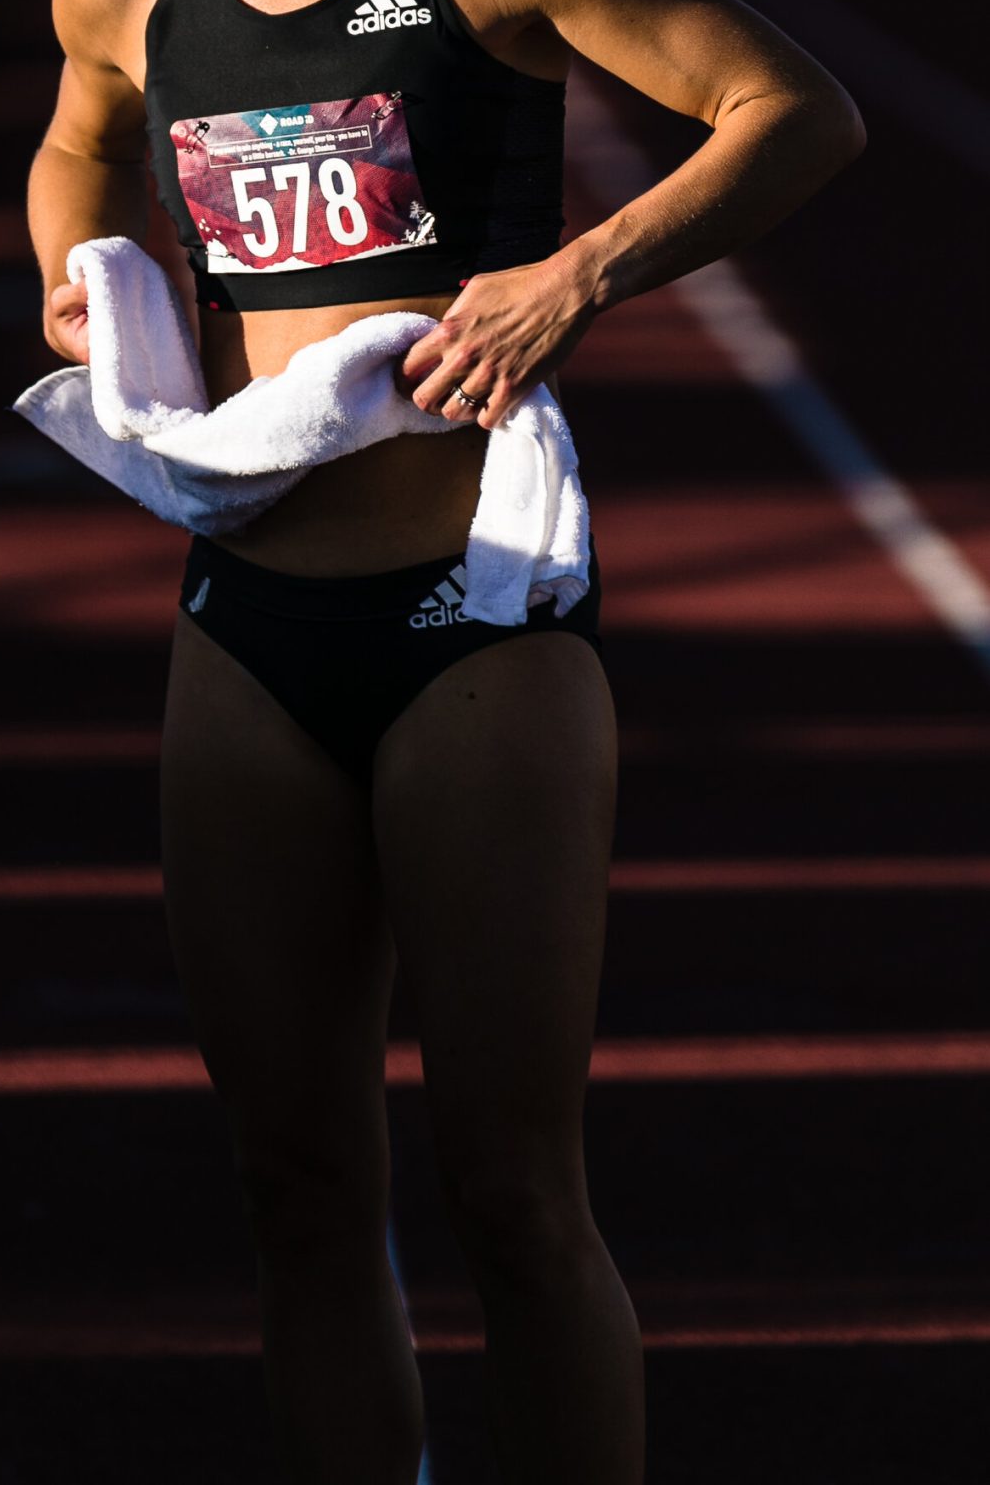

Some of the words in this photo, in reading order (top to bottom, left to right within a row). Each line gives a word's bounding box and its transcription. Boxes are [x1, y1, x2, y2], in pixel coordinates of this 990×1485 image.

[347, 7, 432, 35] adidas
[280, 116, 304, 127] ROAD
[230, 157, 368, 258] 578
[408, 603, 474, 630] adi
